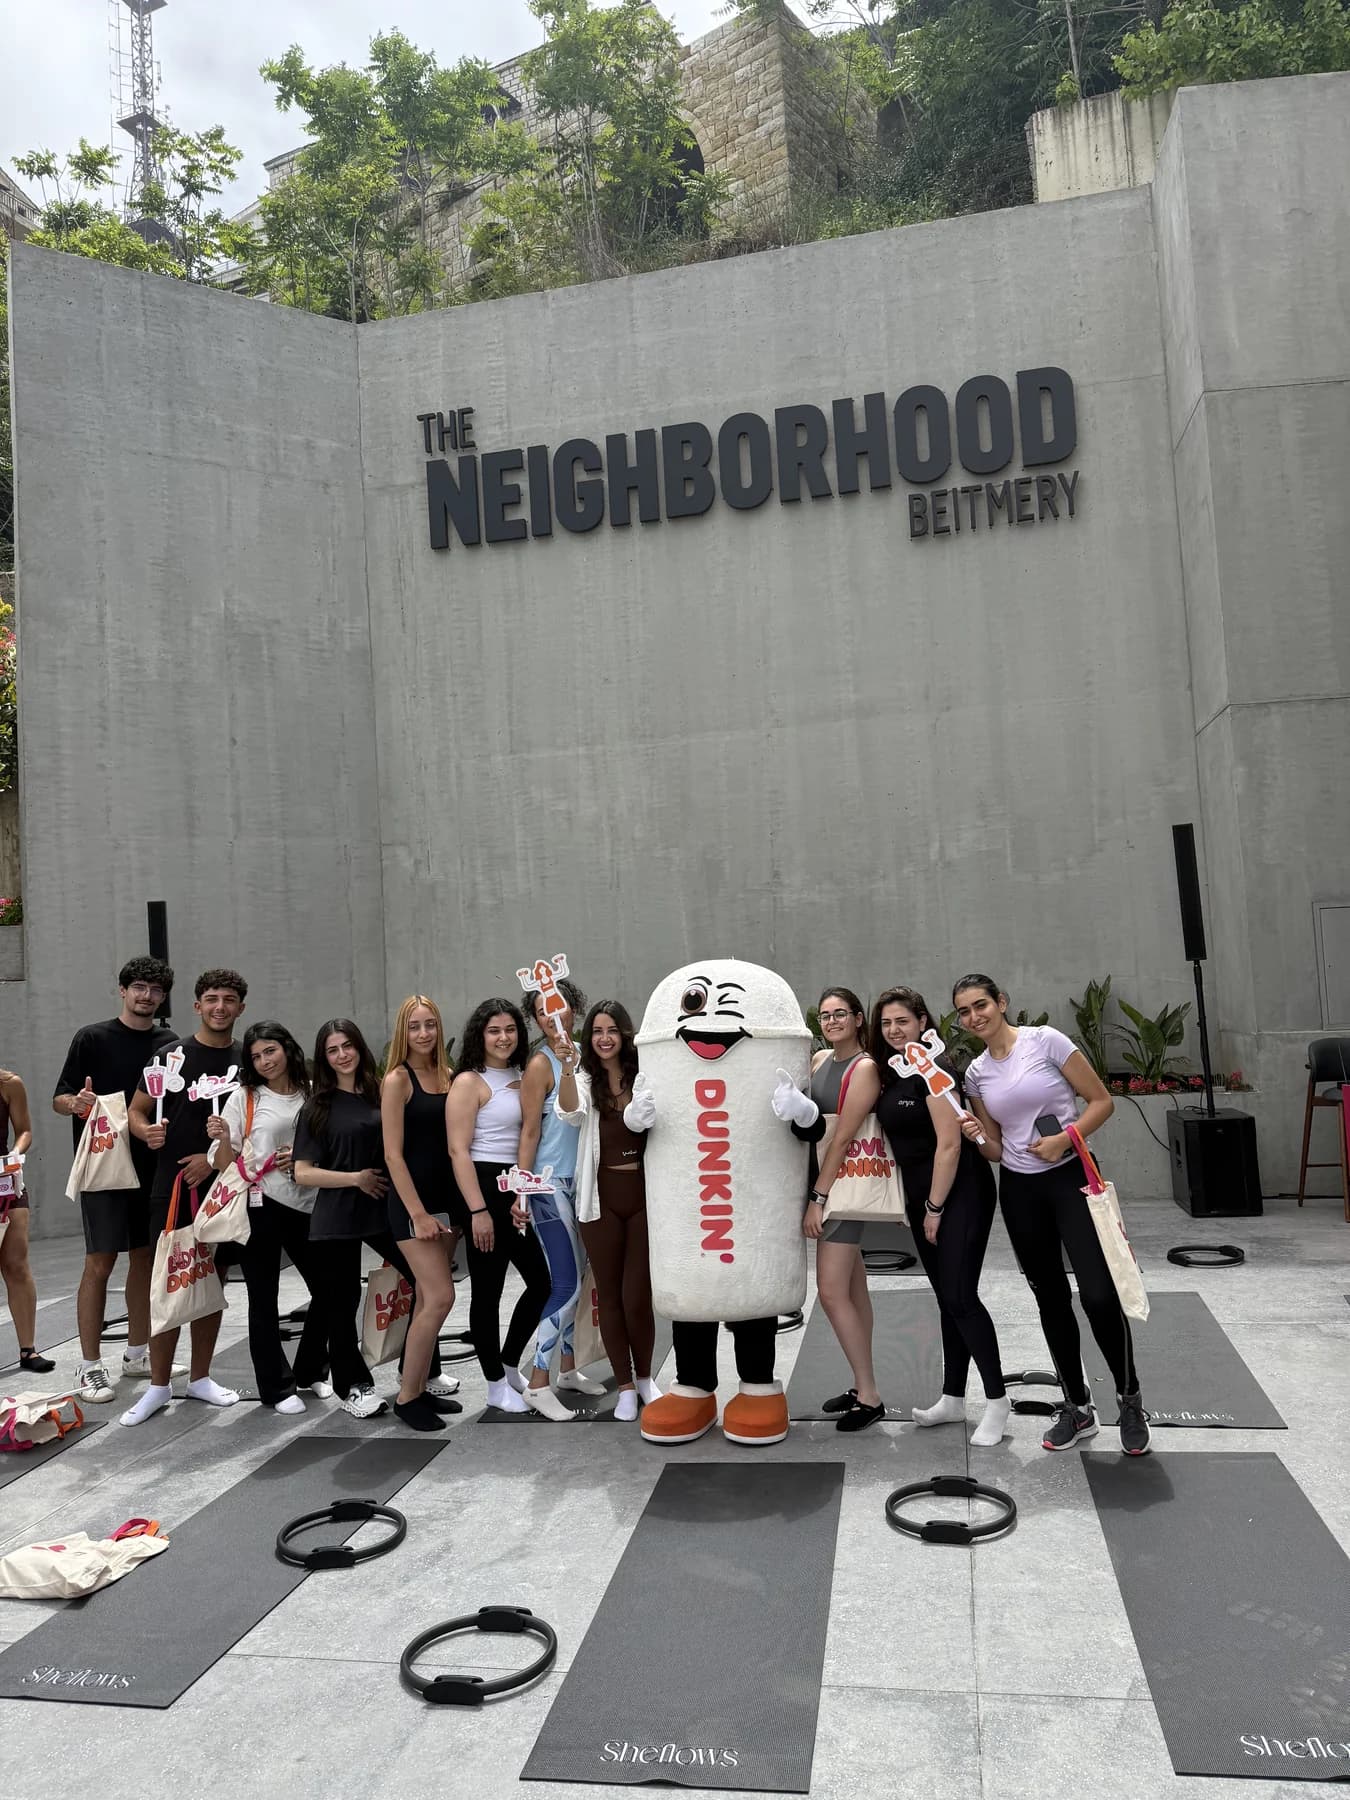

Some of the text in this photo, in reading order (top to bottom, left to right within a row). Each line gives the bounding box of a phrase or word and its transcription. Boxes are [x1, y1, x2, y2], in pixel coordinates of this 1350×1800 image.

[417, 407, 476, 454] THE
[426, 366, 1077, 550] NEIGHBORHOOD
[908, 470, 1080, 540] BEITMERY
[846, 1137, 887, 1158] OVE
[695, 1079, 735, 1264] DUNKIN'
[600, 1740, 739, 1767] Sheflows
[1240, 1735, 1350, 1758] Sheflo
